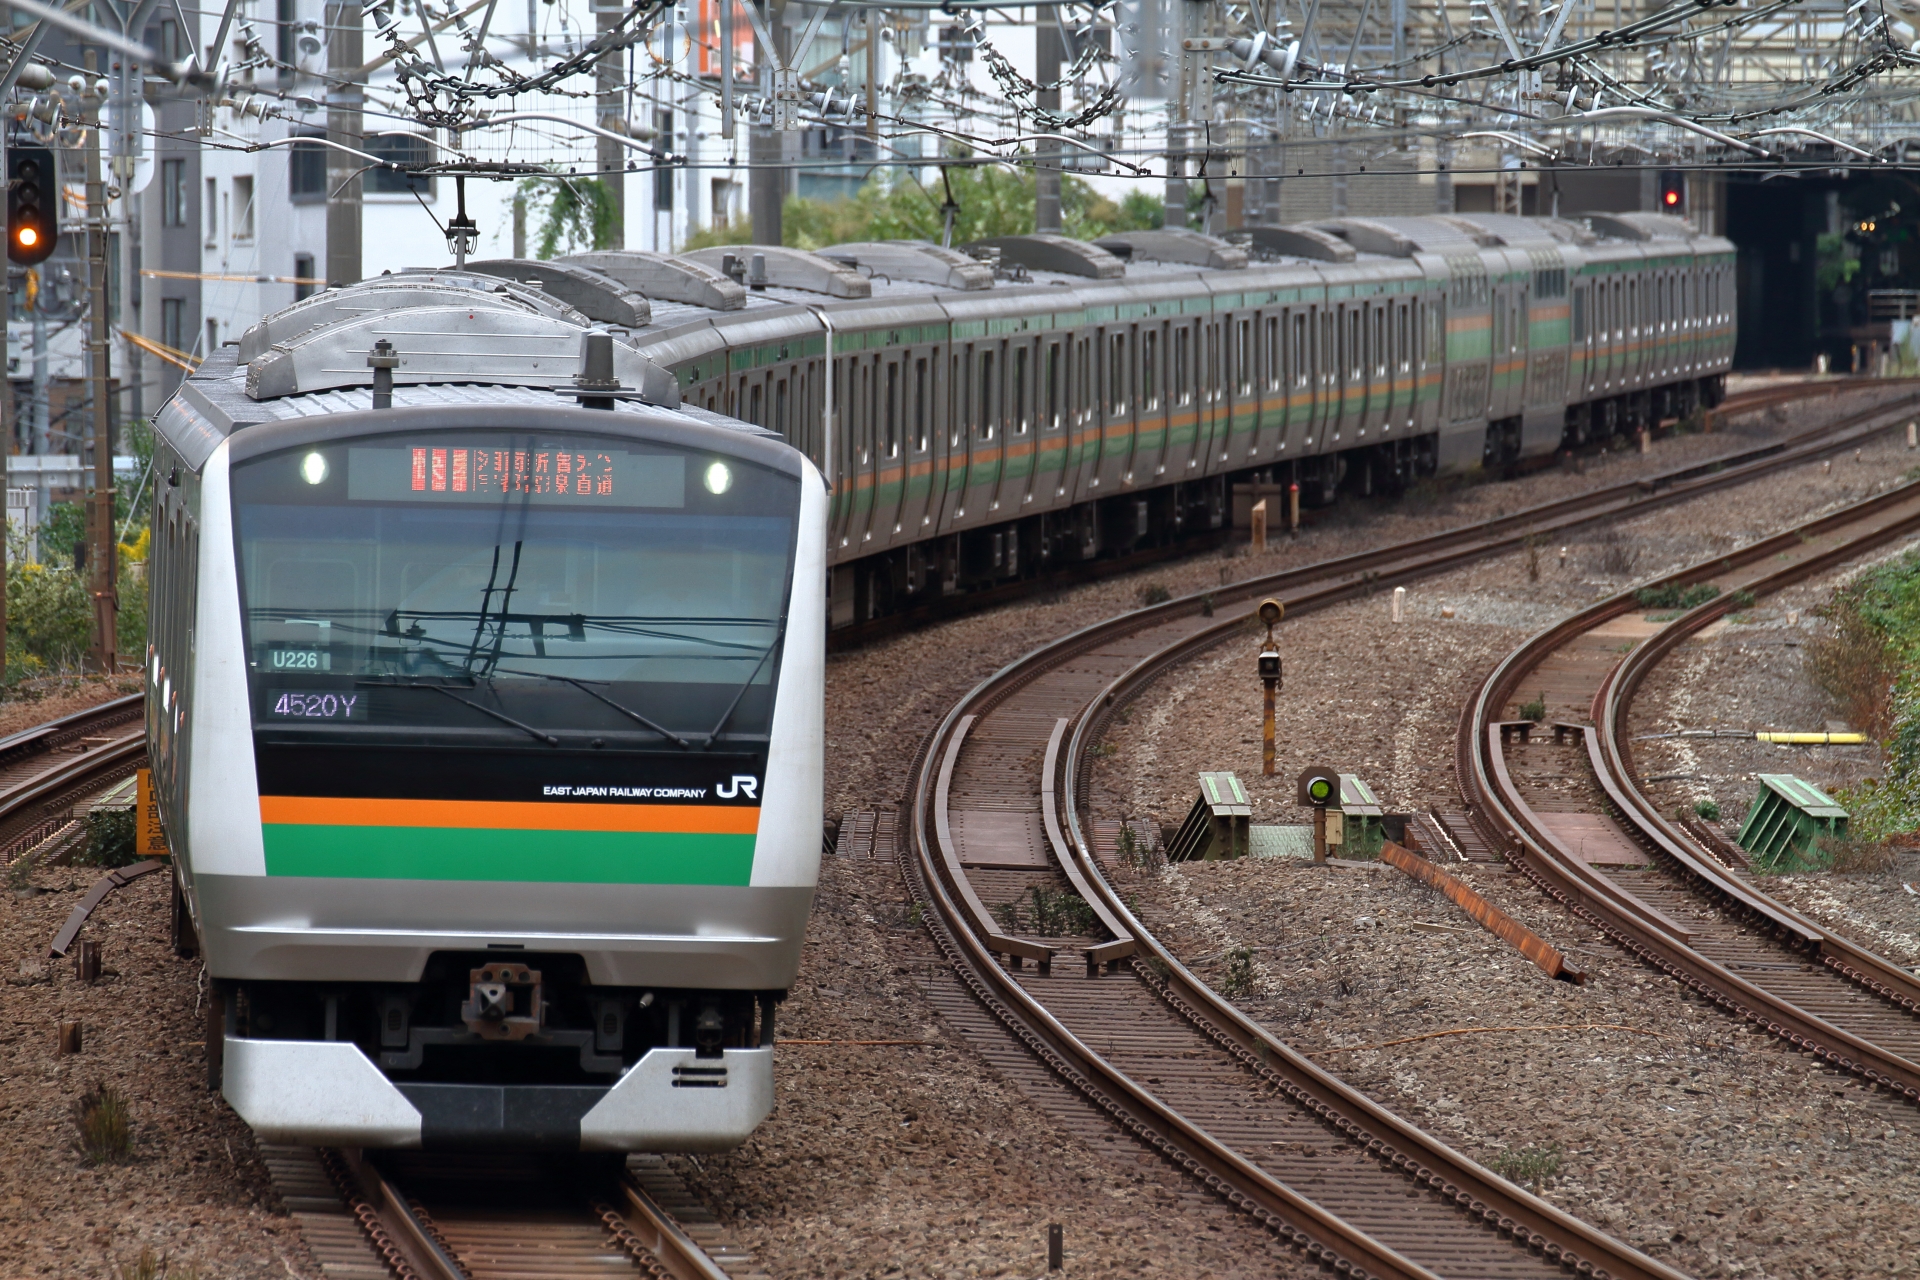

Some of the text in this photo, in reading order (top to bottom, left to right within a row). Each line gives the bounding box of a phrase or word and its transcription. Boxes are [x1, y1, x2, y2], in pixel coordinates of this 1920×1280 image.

[273, 651, 318, 668] U226
[274, 693, 357, 717] 4520Y
[543, 786, 707, 798] EAST JAPAN RAILWAY COMPANY
[716, 775, 758, 799] JR
